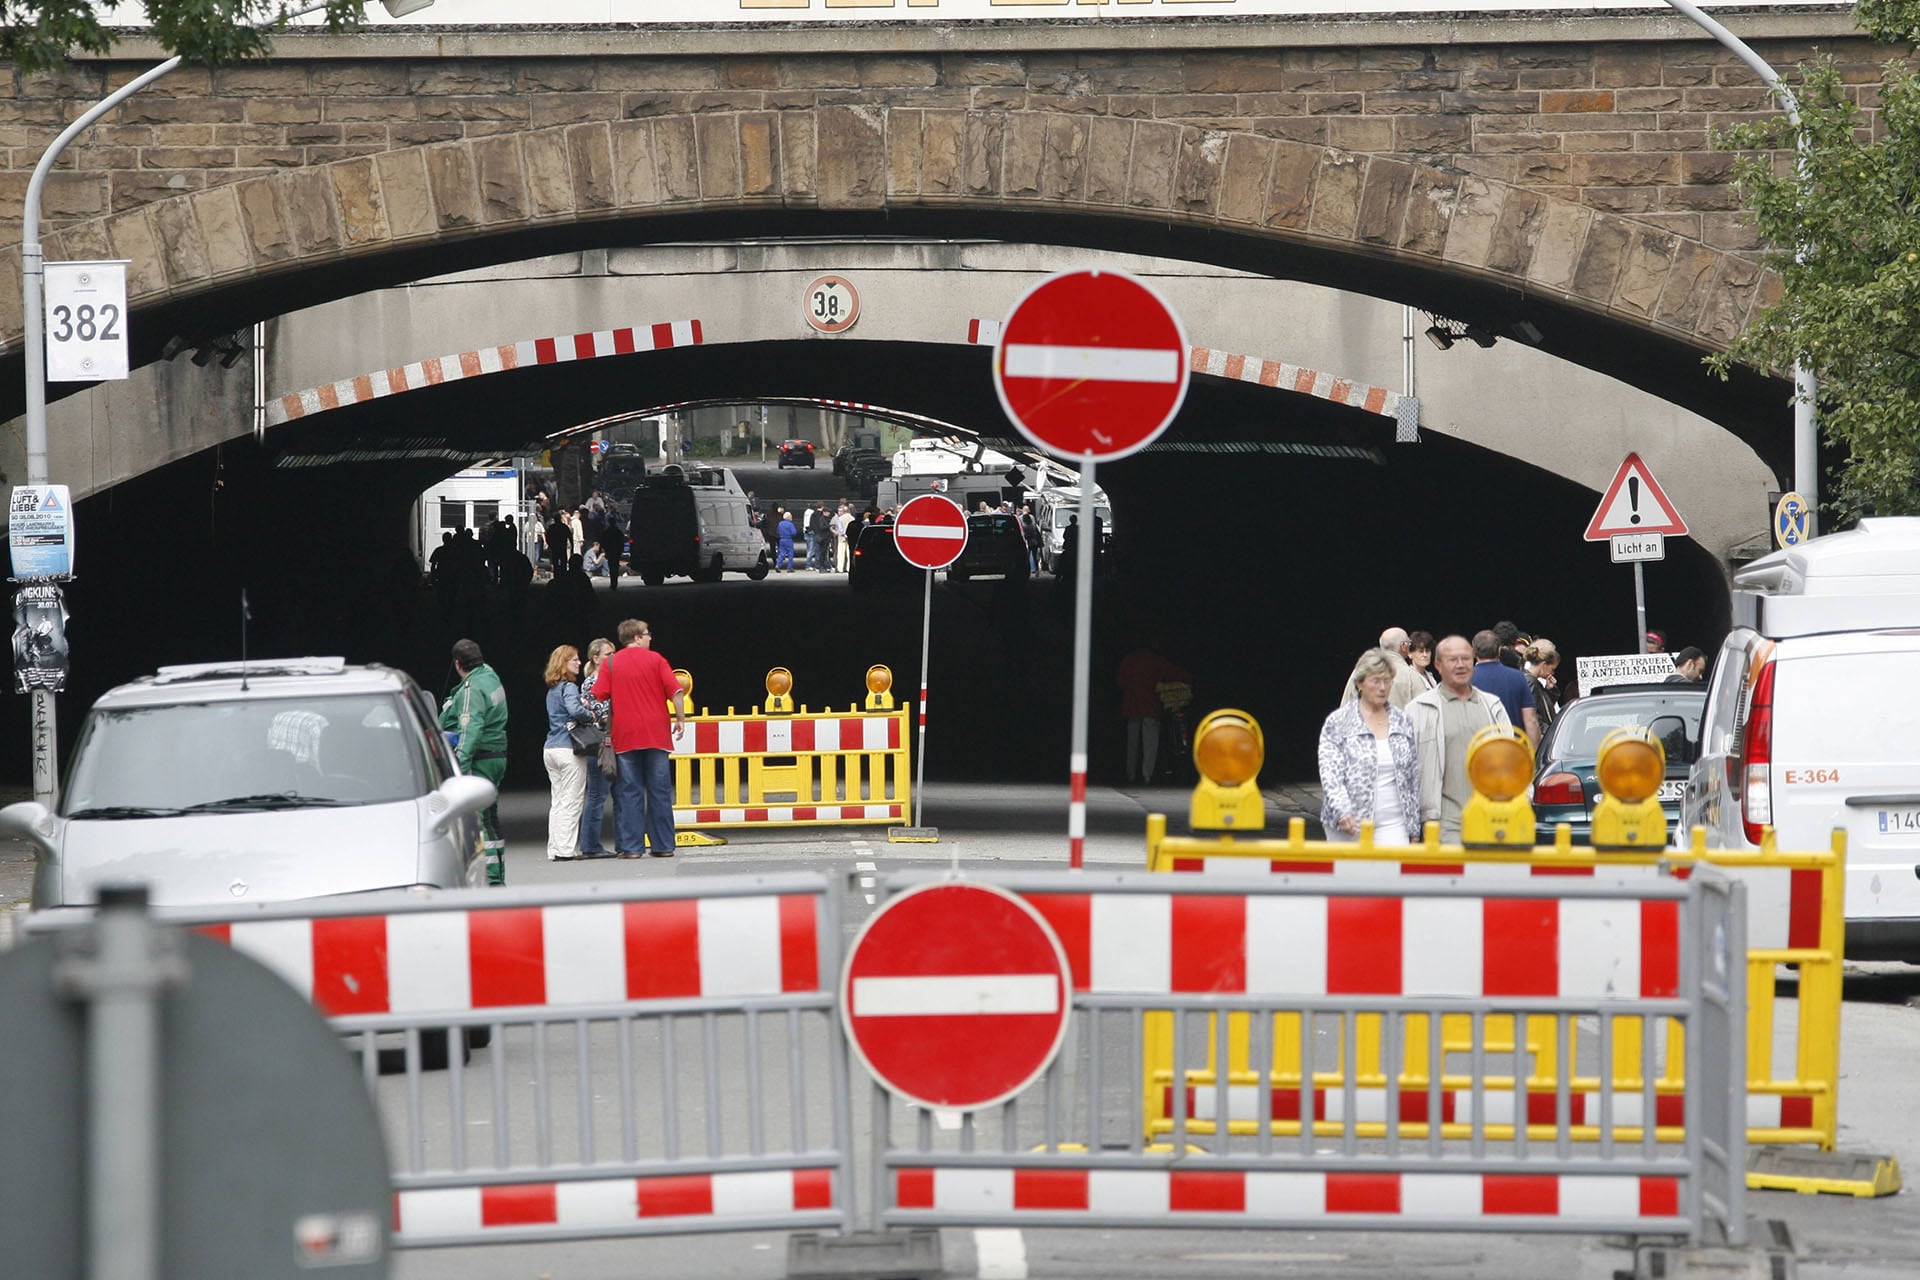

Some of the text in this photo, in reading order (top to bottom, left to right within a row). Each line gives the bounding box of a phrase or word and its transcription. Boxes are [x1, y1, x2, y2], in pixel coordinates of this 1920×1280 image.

[814, 291, 838, 319] 3,8
[52, 303, 120, 342] 382
[11, 504, 37, 512] LIEBE
[1617, 542, 1657, 554] Licht an
[37, 601, 58, 609] 30.07.1
[1580, 657, 1668, 668] IN TIEFER TRAUER
[1580, 664, 1675, 678] & ANTEILNAHME
[1785, 769, 1840, 784] E-364
